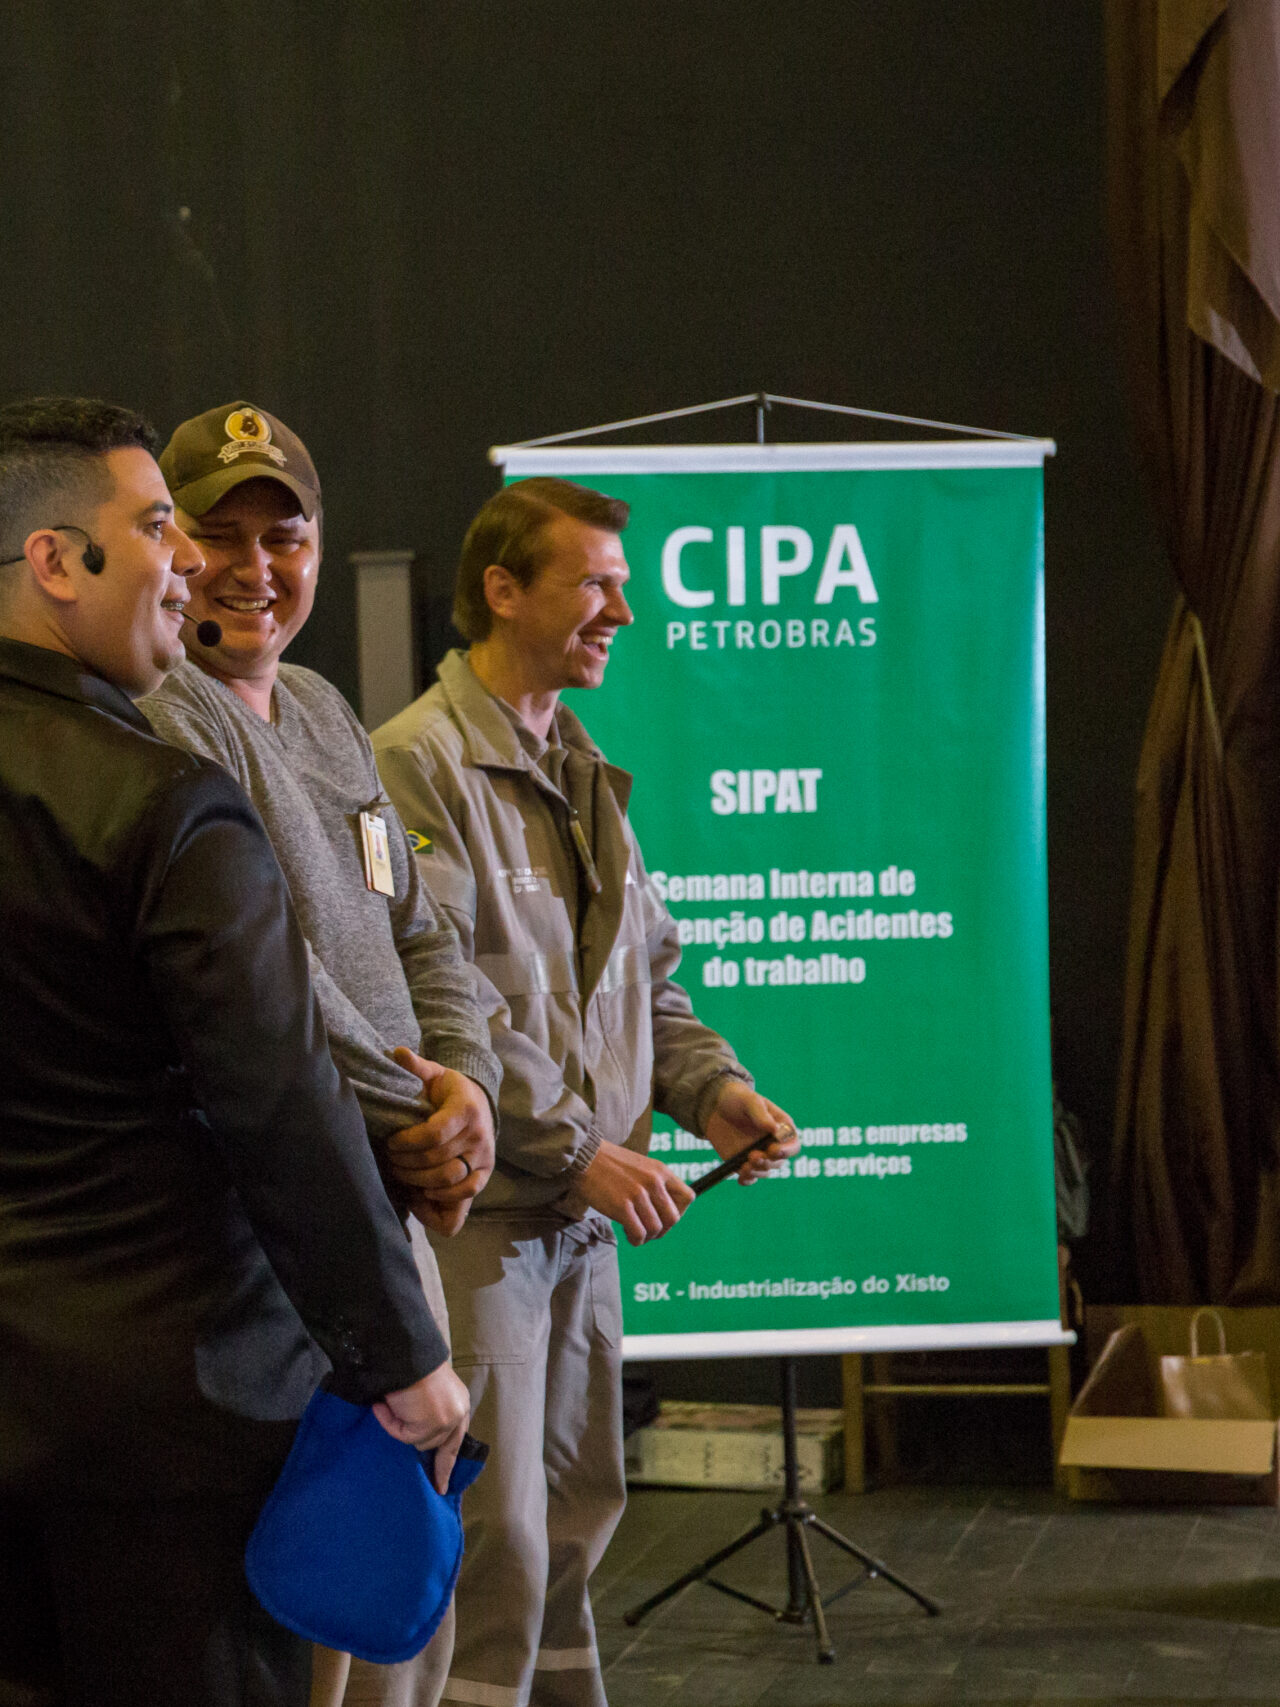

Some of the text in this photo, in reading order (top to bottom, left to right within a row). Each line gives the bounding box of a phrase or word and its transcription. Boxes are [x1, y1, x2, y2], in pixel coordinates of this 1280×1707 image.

[661, 523, 879, 608] CIPA
[666, 617, 877, 650] PETROBRAS
[710, 768, 823, 815] SIPAT
[651, 865, 916, 902] Semana Interna de
[678, 908, 954, 950] enção de Acidentes
[703, 953, 866, 988] do trabalho
[837, 1126, 863, 1146] as
[865, 1122, 968, 1147] empresas
[793, 1154, 821, 1178] de
[823, 1152, 912, 1179] serviços
[633, 1282, 670, 1302] SIX
[689, 1276, 857, 1300] Industrialização
[861, 1275, 890, 1295] do
[895, 1273, 950, 1293] Xisto
